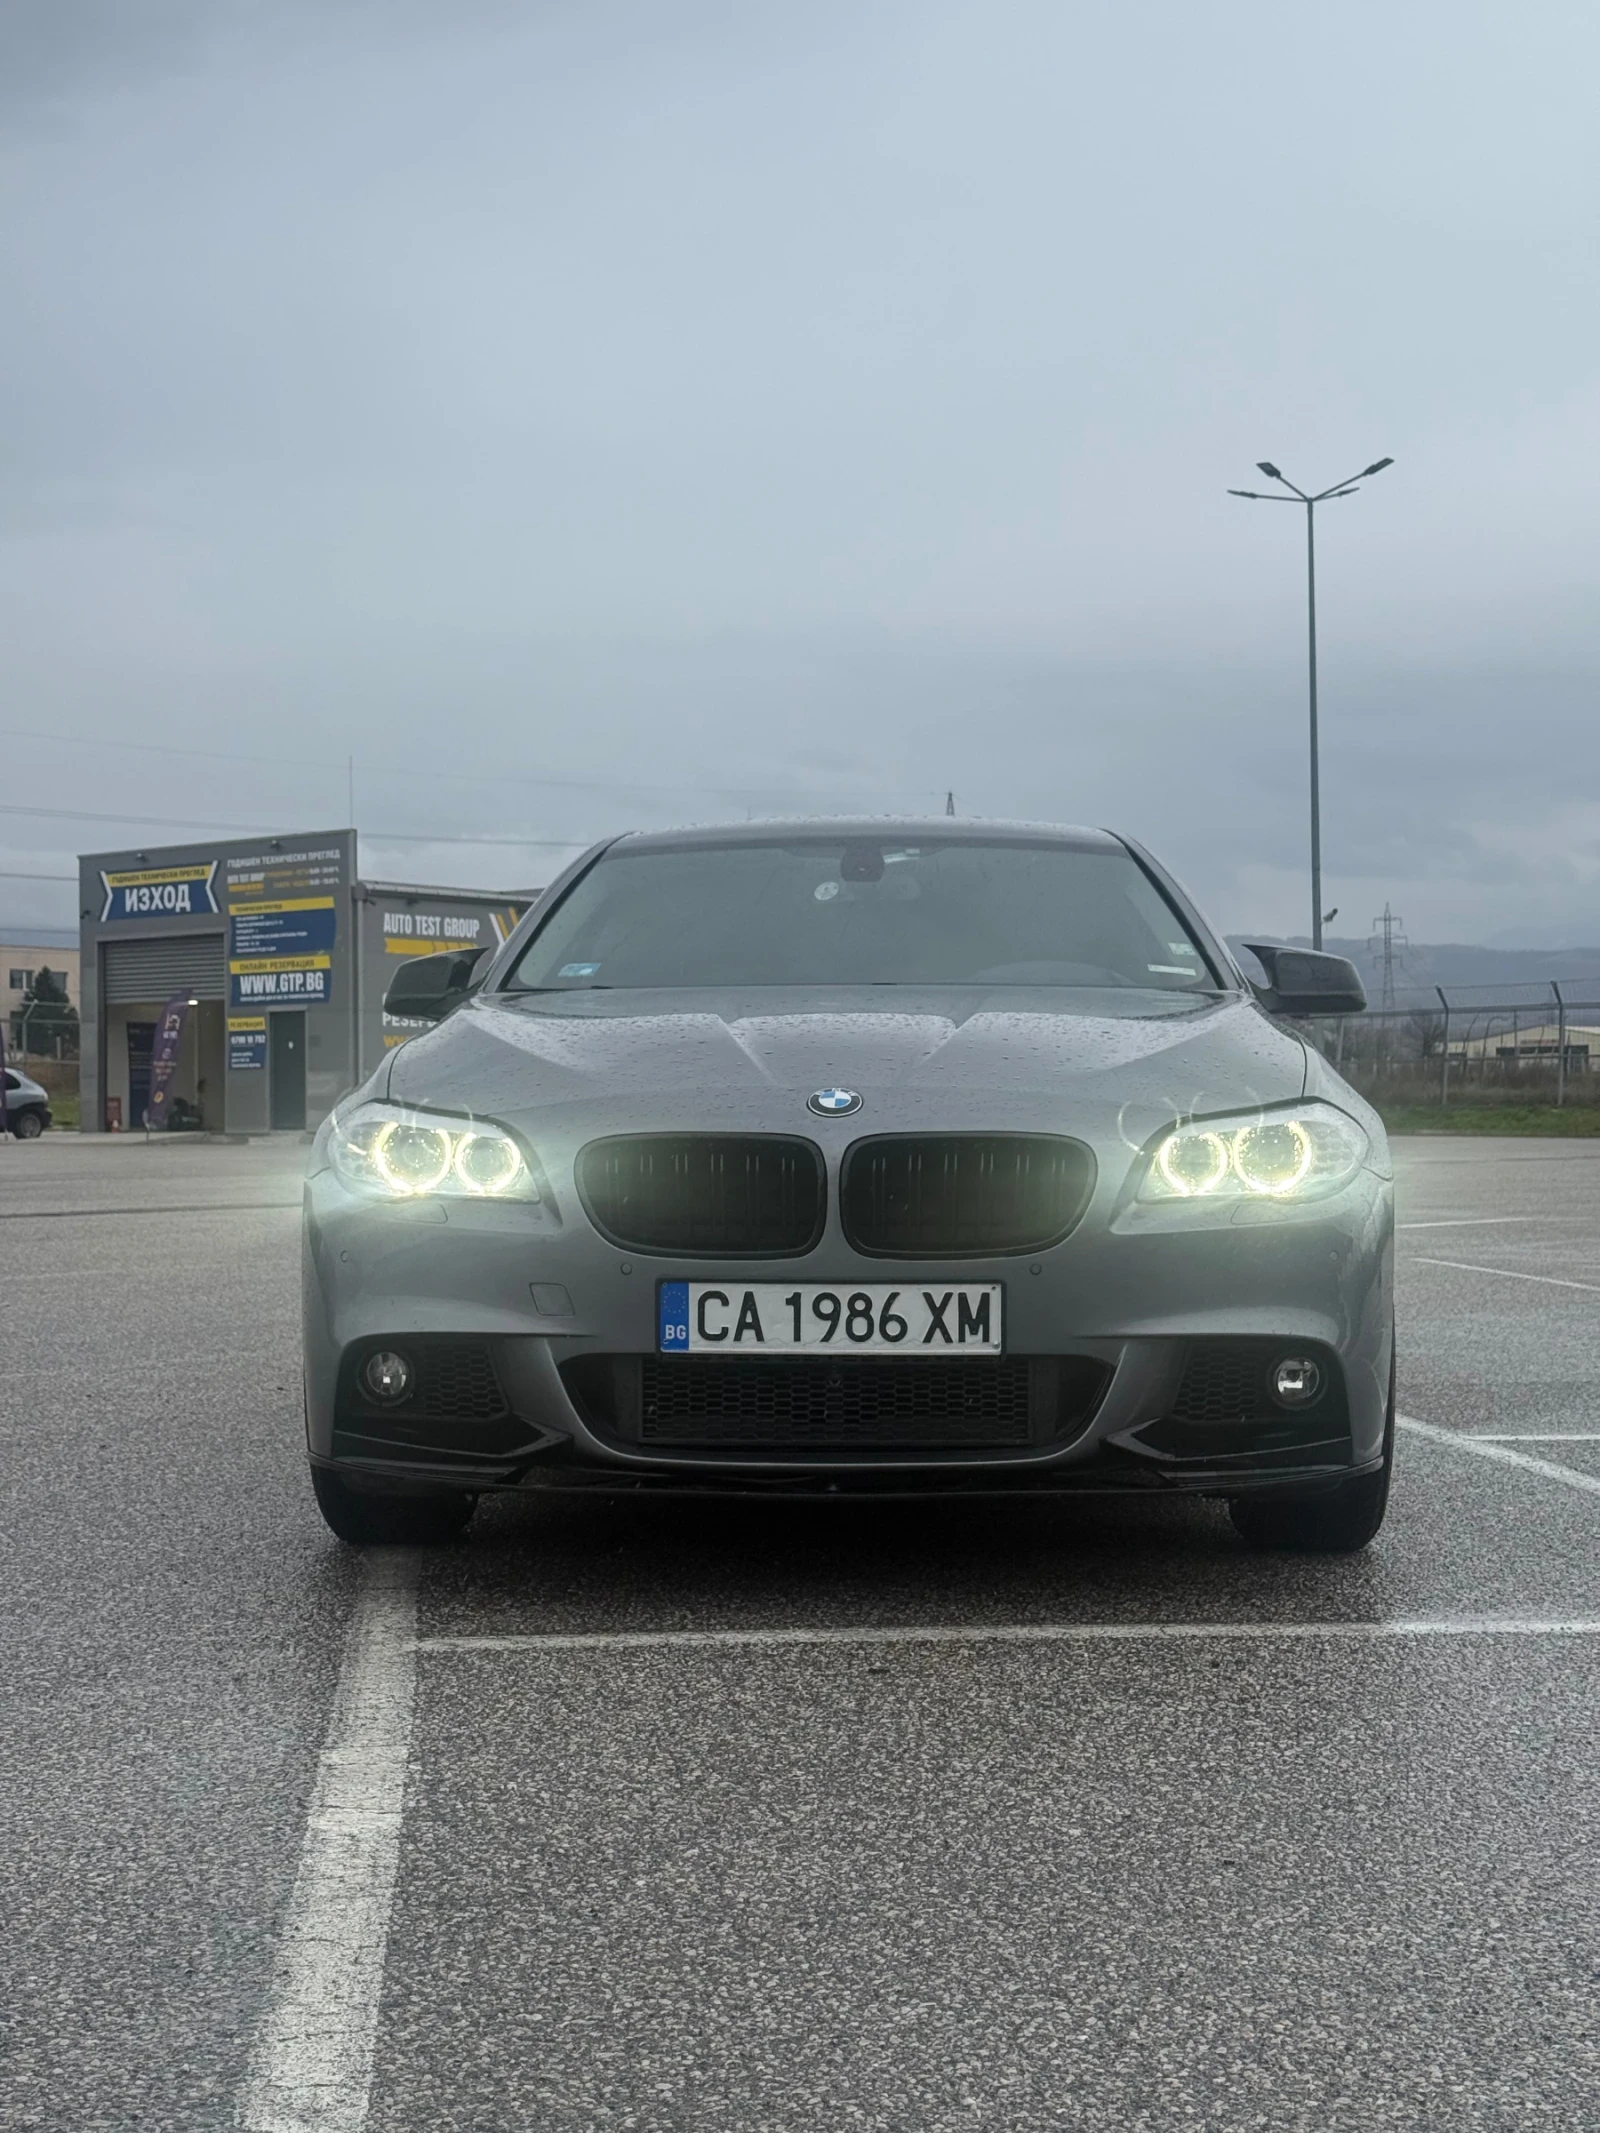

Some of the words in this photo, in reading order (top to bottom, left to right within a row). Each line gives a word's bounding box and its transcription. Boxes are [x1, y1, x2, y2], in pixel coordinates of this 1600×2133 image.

[227, 857, 261, 868] ГОДИШЕН
[262, 853, 307, 865] ТЕХНИЧЕСКИ
[308, 849, 341, 861] ПРЕГЛЕД
[124, 884, 191, 913] ИЗХОД
[383, 912, 412, 935] AUTO
[414, 915, 442, 936] TEST
[444, 916, 480, 939] GROUP
[239, 962, 267, 971] ОНЛАЙН
[270, 960, 315, 969] РЕЗЕРВАЦИЯ
[240, 971, 324, 995] WWW.GTP.BG
[697, 1290, 765, 1343] CA
[785, 1291, 909, 1343] 1986
[922, 1291, 991, 1343] XM
[665, 1325, 687, 1340] BG
